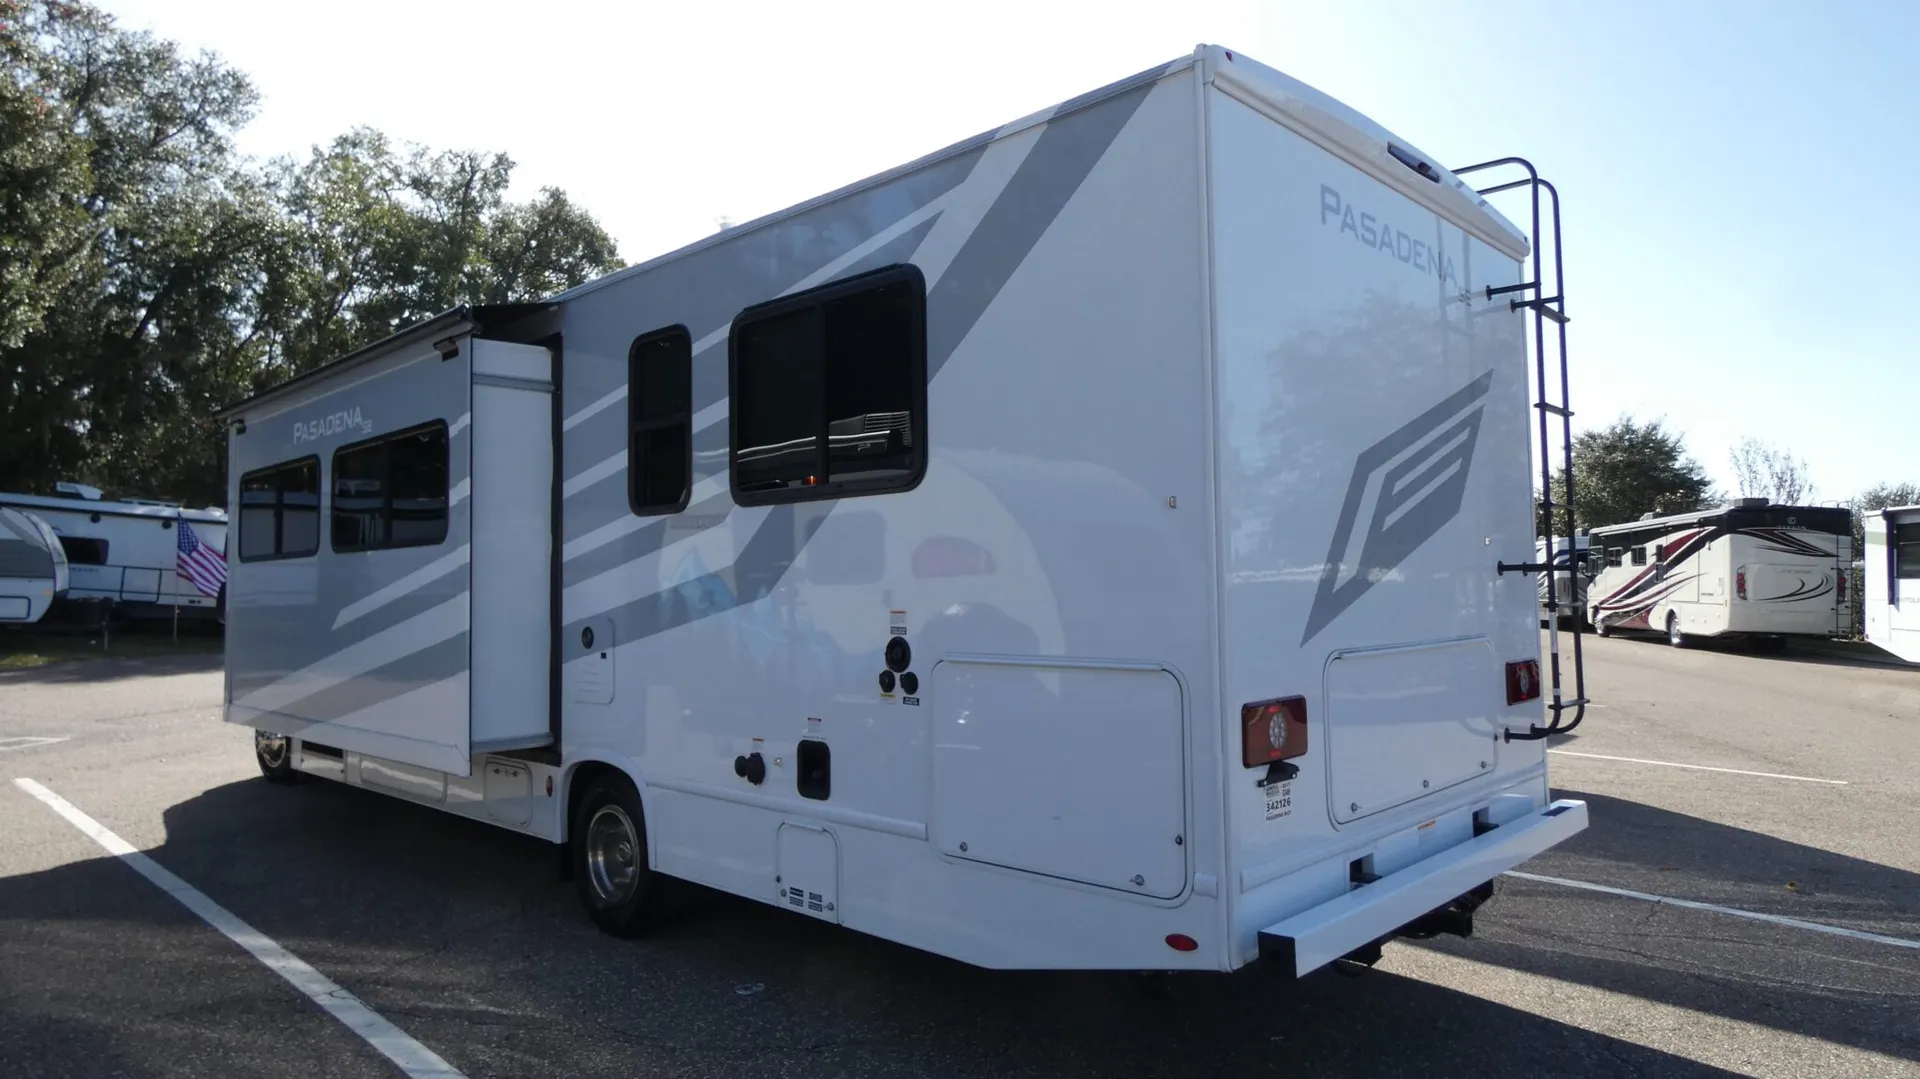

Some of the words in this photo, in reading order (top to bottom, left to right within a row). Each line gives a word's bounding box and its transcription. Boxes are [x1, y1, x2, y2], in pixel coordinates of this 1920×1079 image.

[1320, 183, 1458, 287] PASADENA
[293, 406, 362, 445] PASADENA
[1266, 797, 1291, 812] 342126
